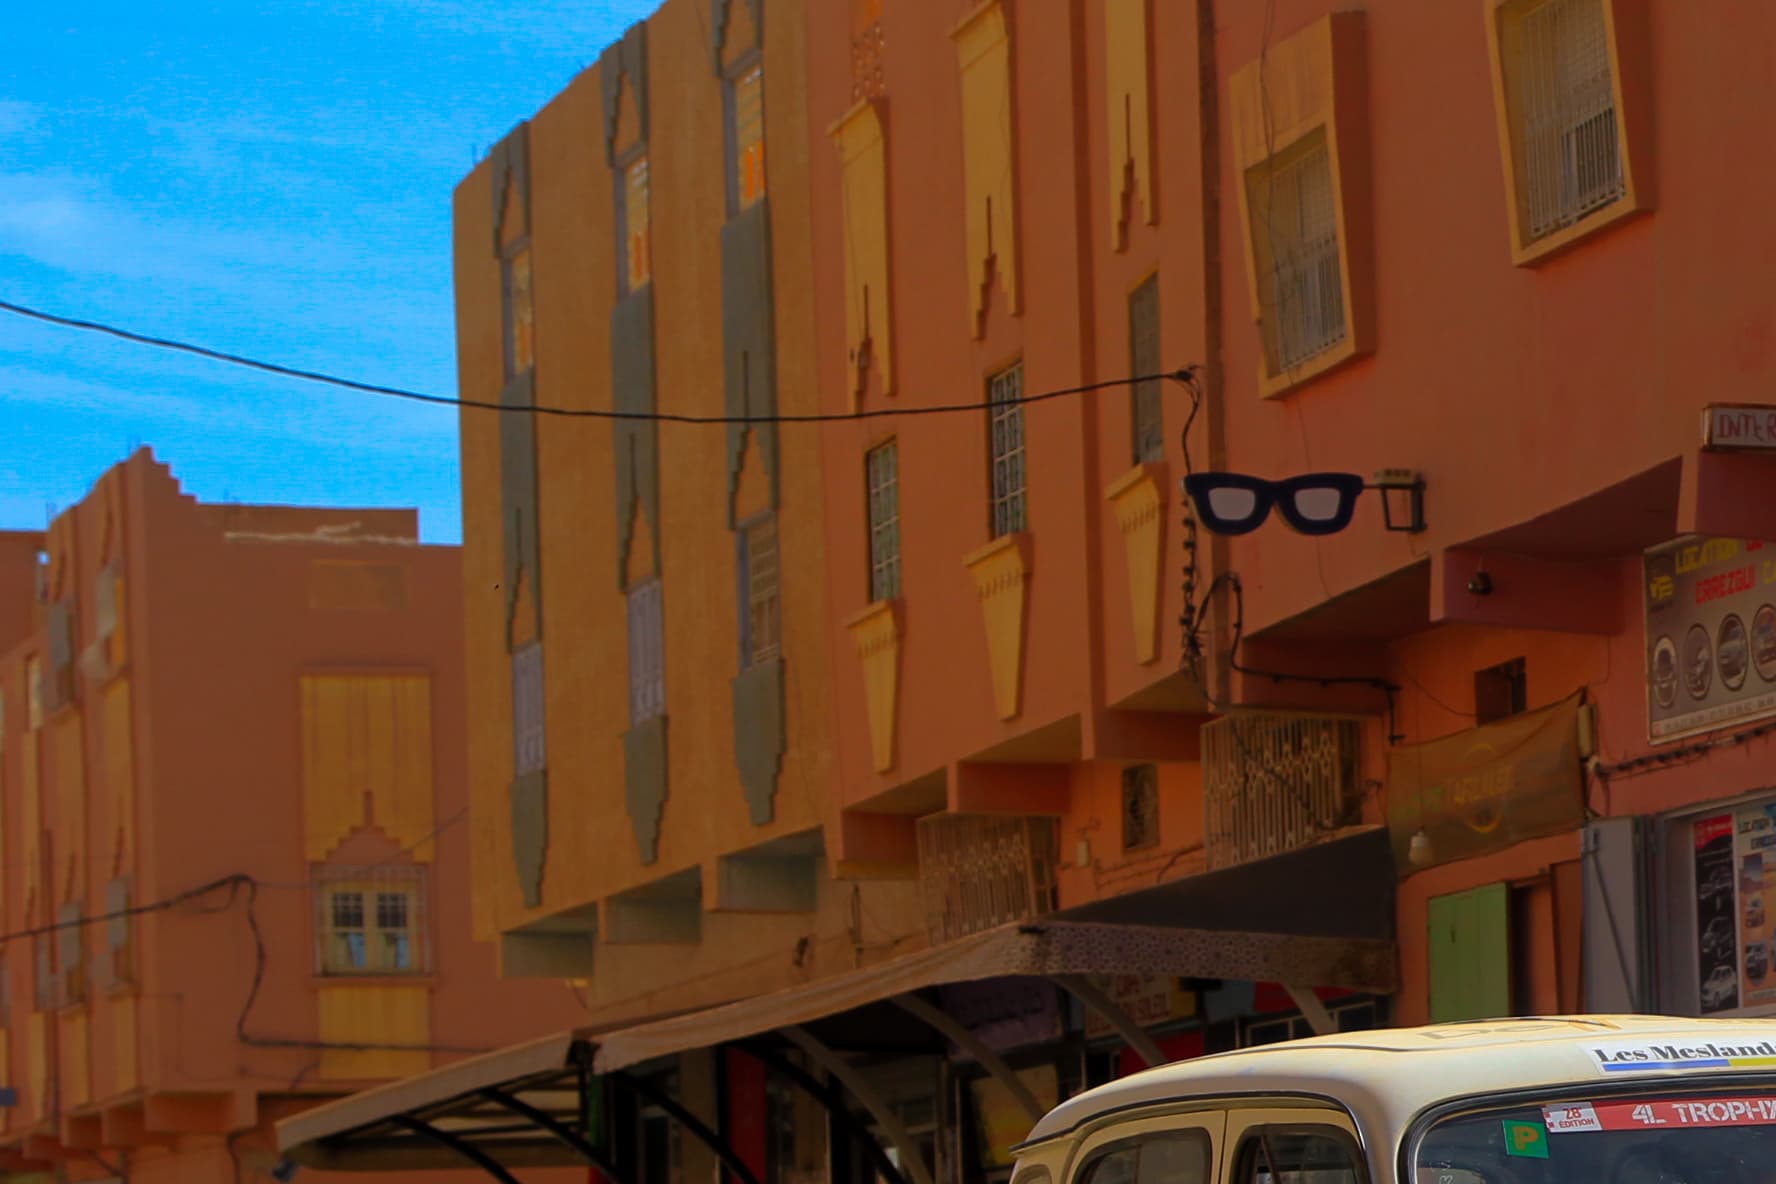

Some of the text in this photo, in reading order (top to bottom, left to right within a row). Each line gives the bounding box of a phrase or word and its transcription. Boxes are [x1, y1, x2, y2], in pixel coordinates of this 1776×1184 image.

[1591, 1047, 1648, 1064] Les
[1631, 1103, 1667, 1125] 4L
[1512, 1125, 1540, 1151] P
